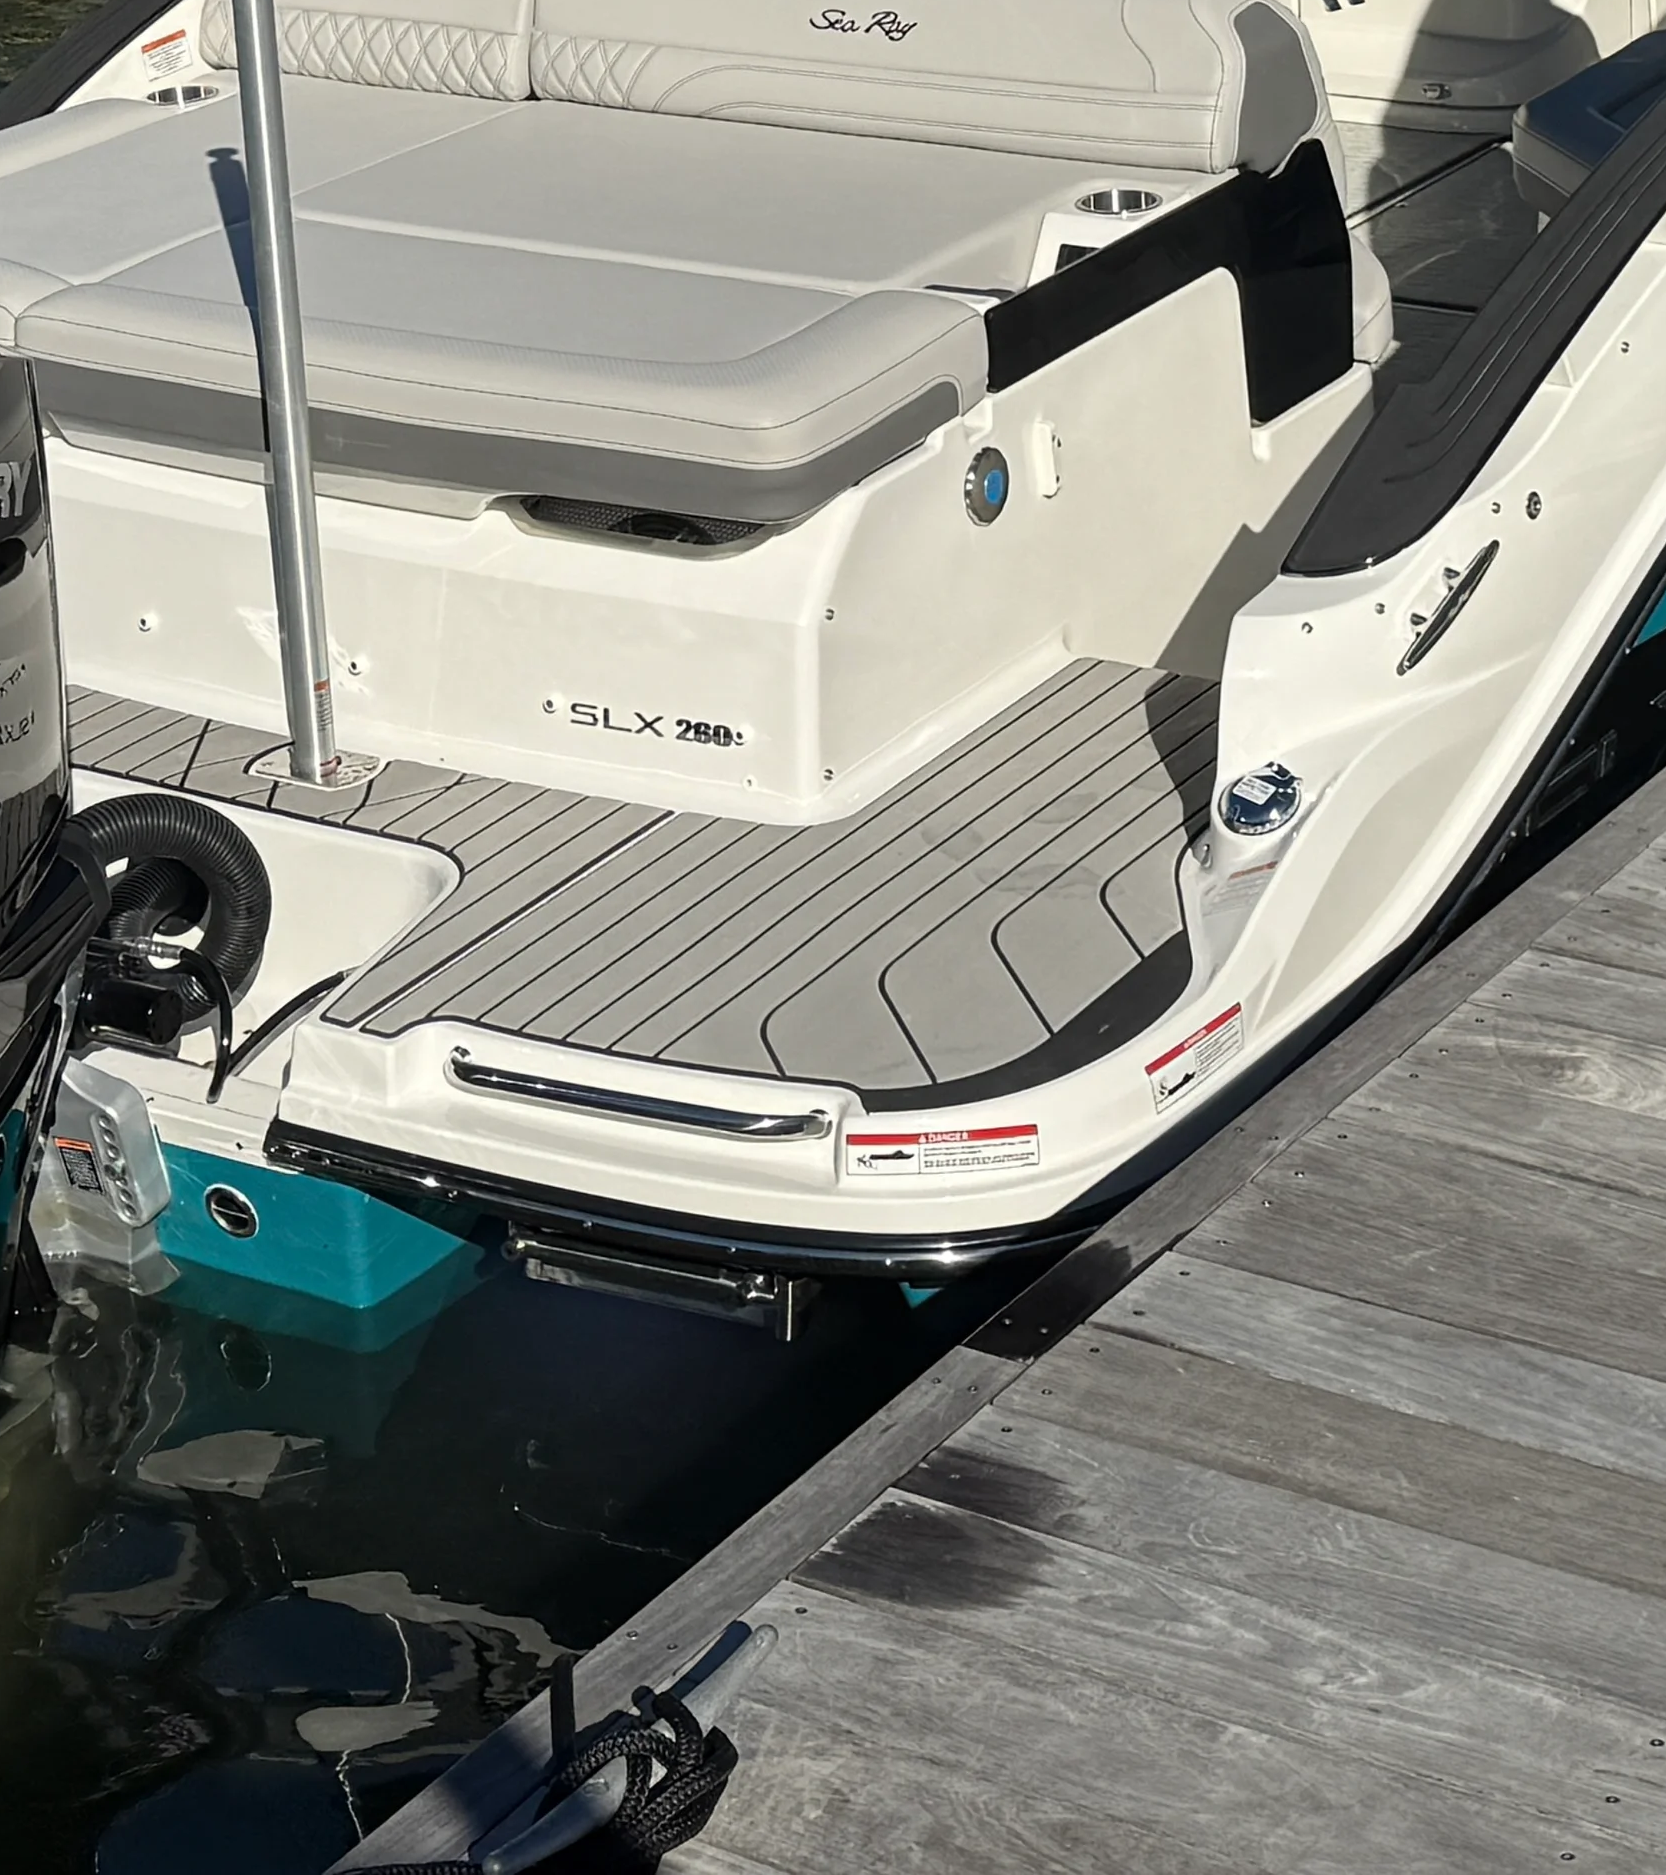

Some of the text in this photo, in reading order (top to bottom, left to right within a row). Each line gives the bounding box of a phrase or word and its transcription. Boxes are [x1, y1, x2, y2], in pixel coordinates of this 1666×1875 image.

[809, 9, 918, 42] Sea Ray
[570, 702, 733, 747] SLX 260
